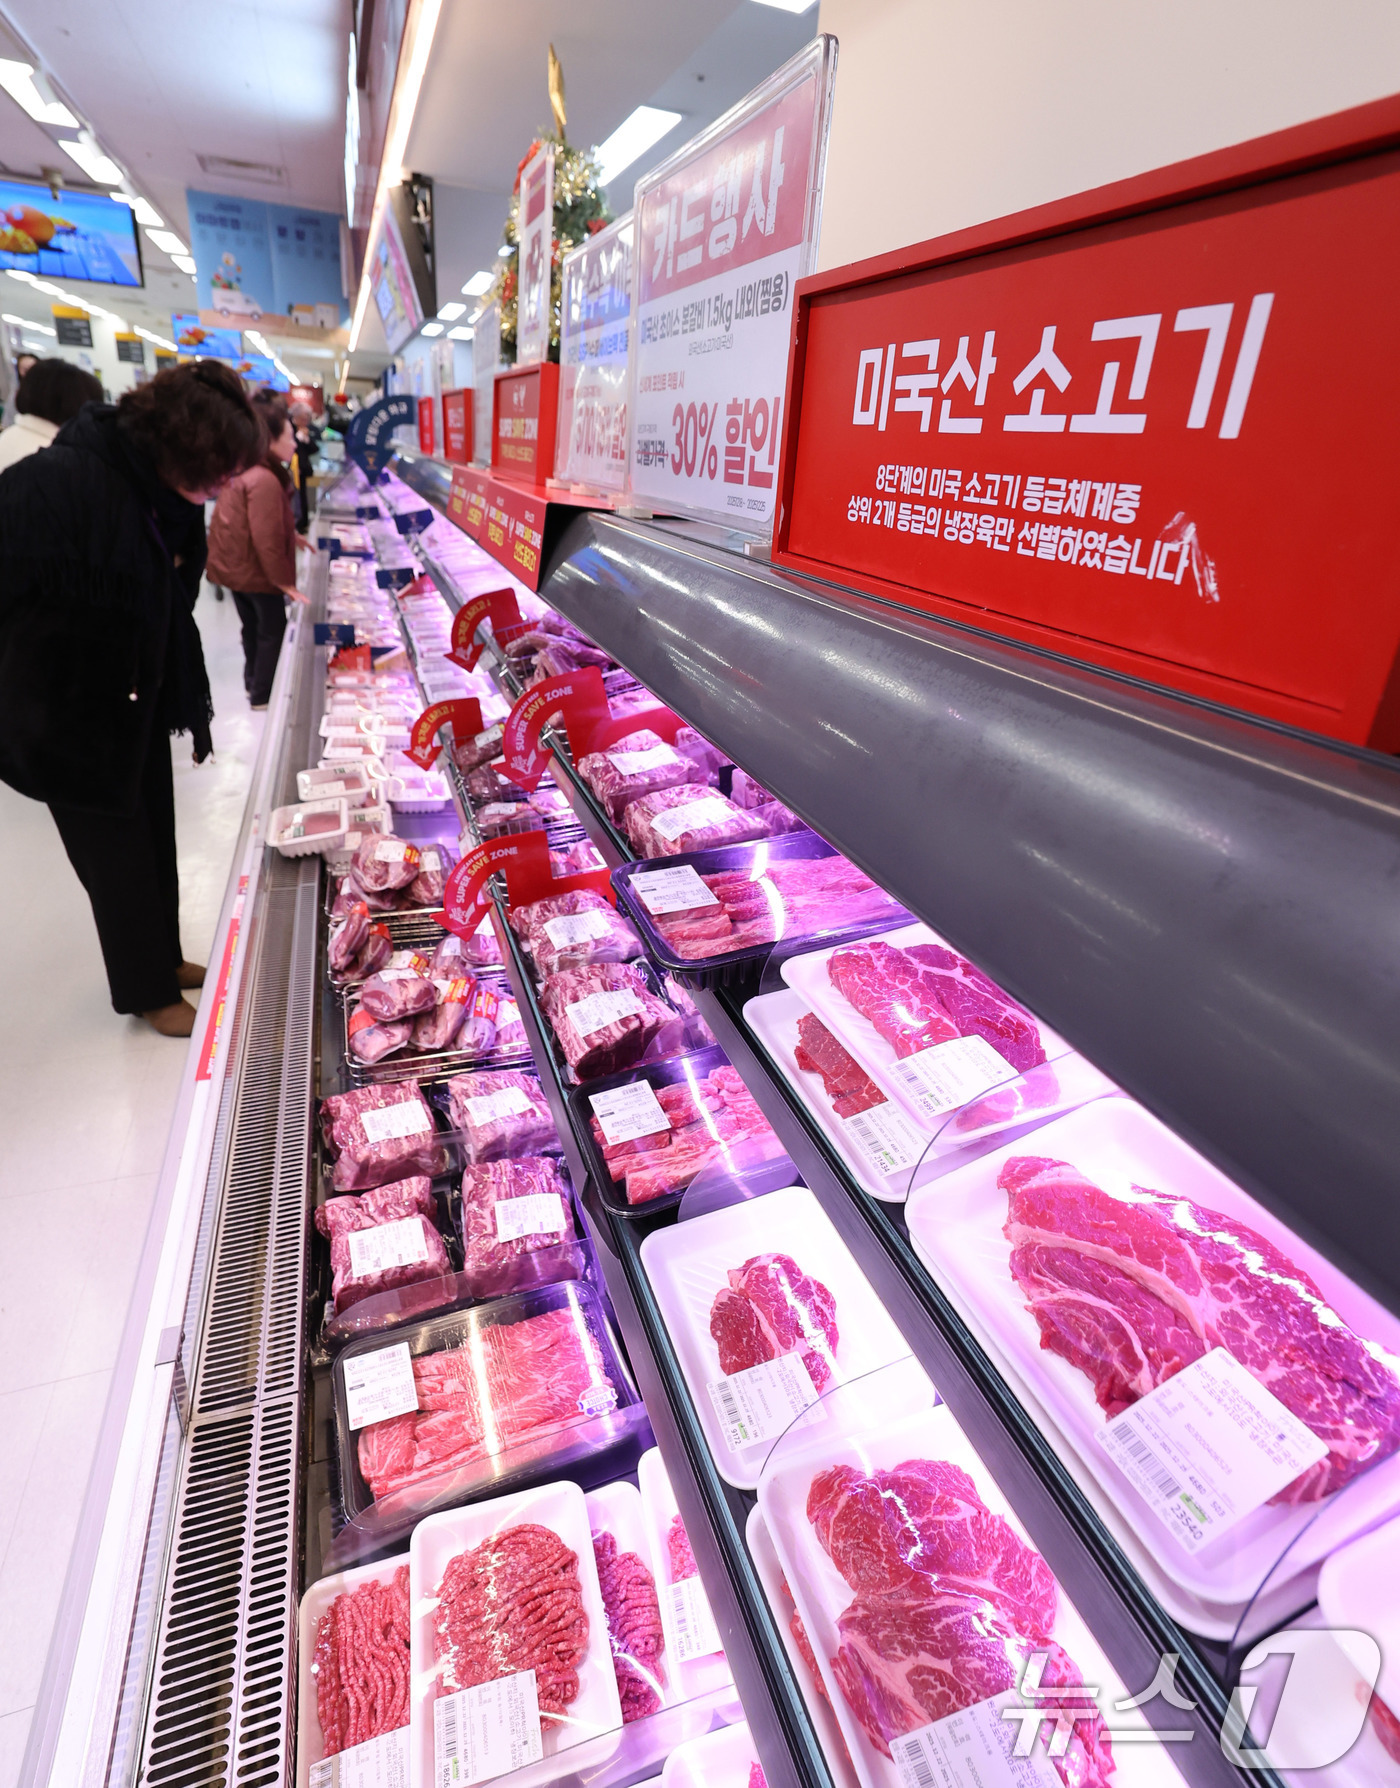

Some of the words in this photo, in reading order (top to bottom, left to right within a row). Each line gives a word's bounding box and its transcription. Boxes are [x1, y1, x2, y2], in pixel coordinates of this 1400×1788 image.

[652, 124, 786, 284] 카드행사
[641, 314, 659, 344] 미국산
[659, 308, 680, 339] 초이스
[681, 298, 706, 335] 본갈비
[706, 293, 733, 332] 1.5kg
[734, 270, 788, 320] 내외(찜용)
[852, 330, 997, 434] 미국산
[1002, 293, 1275, 439] 소고기
[671, 402, 718, 480] 30%
[724, 397, 780, 489] 할인
[876, 465, 928, 497] 8단계의
[929, 470, 962, 501] 미국
[963, 473, 1022, 506] 소고기
[1023, 476, 1142, 524] 등급체계중
[847, 497, 872, 524] 상위
[873, 500, 894, 528] 2개
[896, 503, 942, 537] 등급의
[944, 511, 1015, 552] 냉장육만
[1016, 523, 1190, 584] 선별하였습니다
[512, 700, 529, 730] AMERICAN
[528, 692, 540, 704] BEEF
[516, 720, 528, 751] SUPER
[524, 697, 545, 720] SAVE
[544, 686, 573, 702] ZONE
[454, 858, 474, 884] AMERICAN
[473, 850, 485, 860] BEEF
[456, 876, 471, 903] SUPER
[468, 856, 490, 876] SAVE
[490, 847, 518, 860] ZONE
[919, 1097, 936, 1113] 24991
[873, 1154, 891, 1172] 21434
[730, 1427, 742, 1445] 9172
[1168, 1501, 1205, 1542] 23540
[1208, 1499, 1227, 1518] 503
[924, 1731, 944, 1765] 2025.12.22
